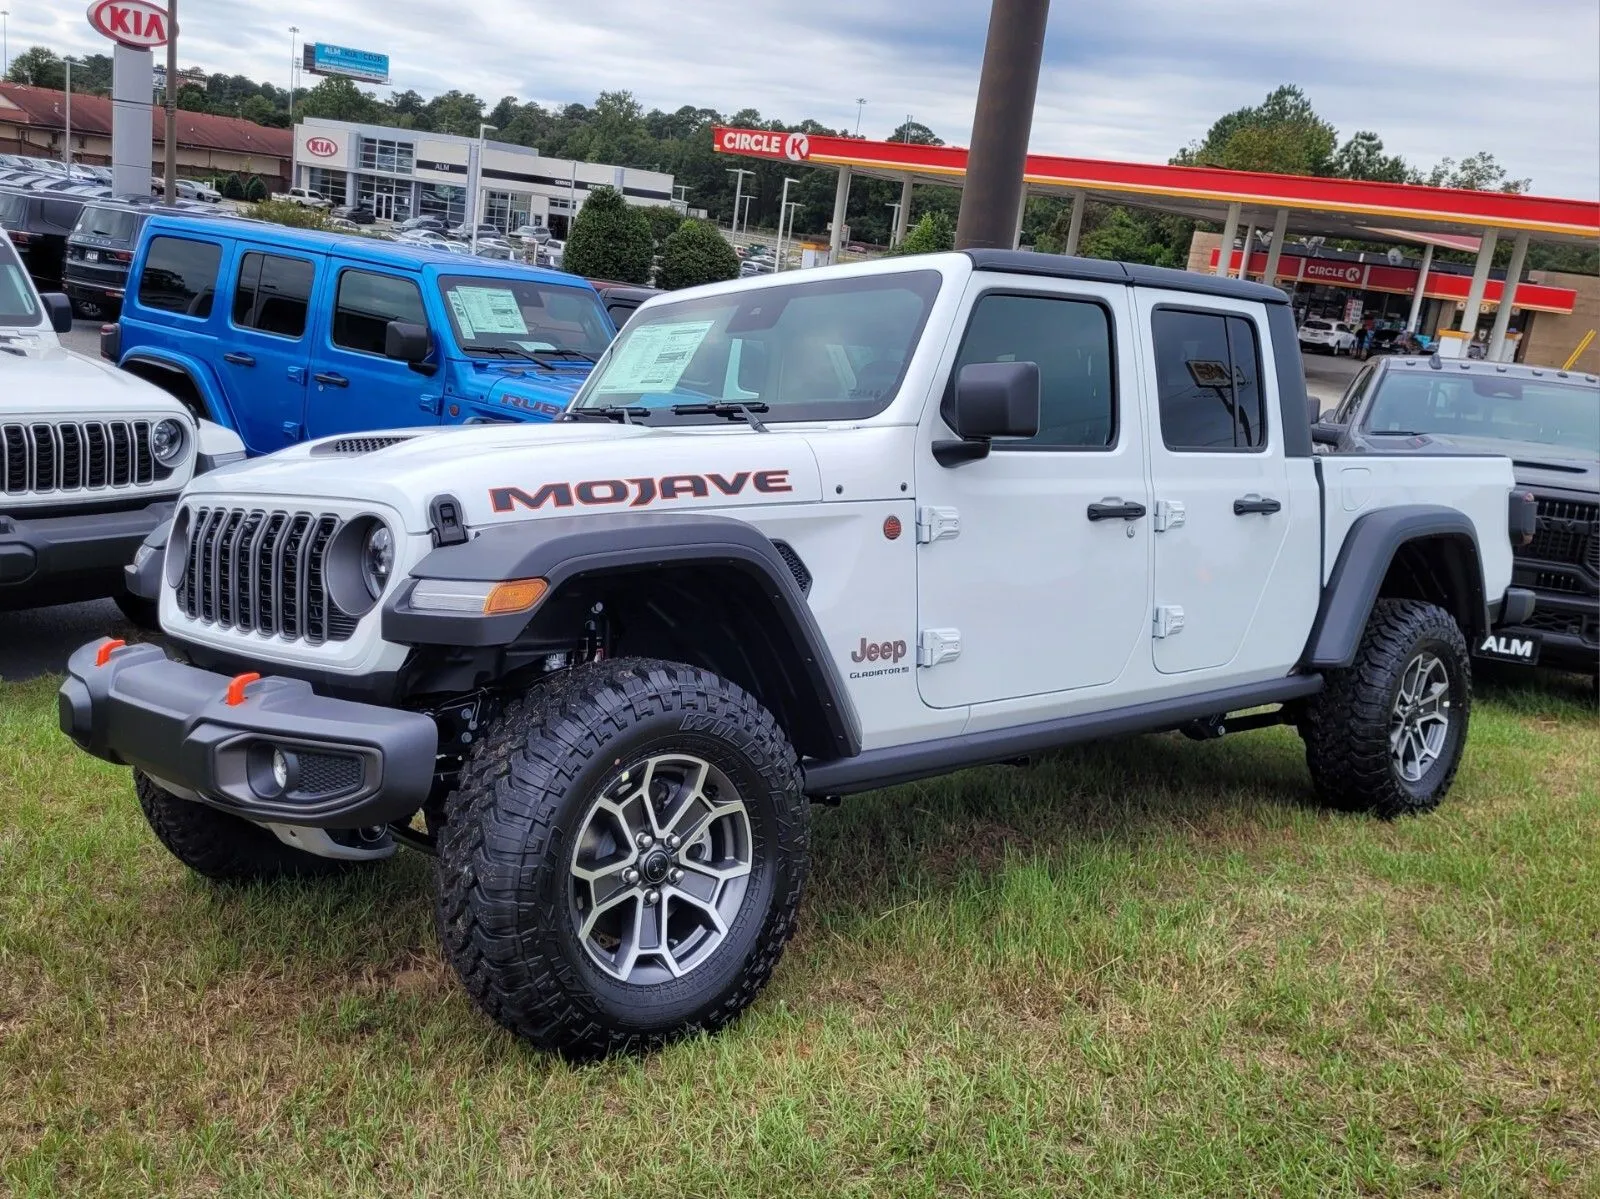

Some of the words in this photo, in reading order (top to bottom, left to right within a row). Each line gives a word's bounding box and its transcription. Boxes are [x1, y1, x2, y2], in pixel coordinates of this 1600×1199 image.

[109, 5, 166, 40] KIA
[324, 46, 341, 56] ALM
[311, 140, 333, 153] KIA
[723, 132, 781, 153] CIRCLE
[789, 136, 807, 160] K
[434, 163, 450, 171] ALM
[86, 252, 98, 260] ALM
[1307, 265, 1344, 278] CIRCLE
[1347, 269, 1359, 280] K
[488, 470, 793, 513] MOJAVE
[851, 637, 907, 664] Jeep
[1481, 635, 1533, 657] ALM
[850, 667, 901, 679] GLADIATOR
